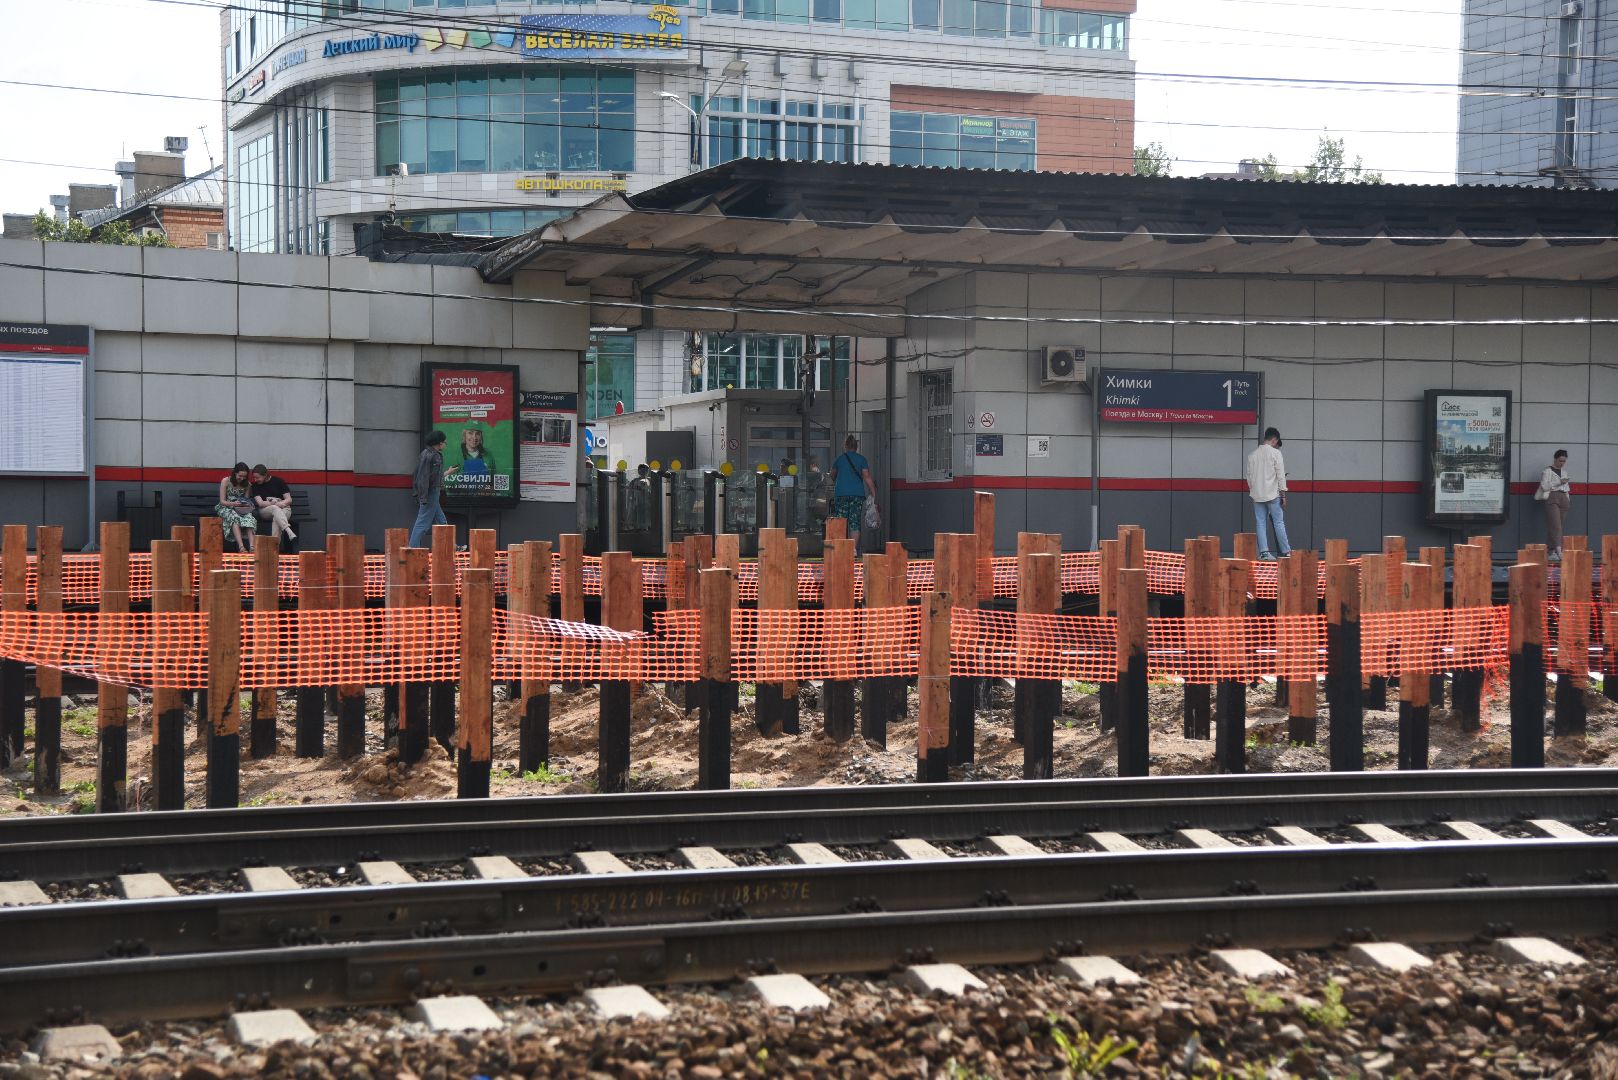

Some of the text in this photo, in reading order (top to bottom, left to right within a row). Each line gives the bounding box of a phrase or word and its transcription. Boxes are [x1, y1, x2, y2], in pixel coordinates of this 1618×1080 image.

[322, 32, 380, 58] Детский
[516, 179, 602, 190] АВТОШКОЛА
[10, 326, 49, 335] поездов
[440, 377, 478, 386] ХОРОШО
[1106, 375, 1152, 389] Химки
[440, 387, 505, 396] УСТРОИЛАСЬ
[1222, 379, 1232, 408] 1
[1105, 395, 1140, 405] Khimki
[444, 474, 491, 483] КУСВИЛЛ
